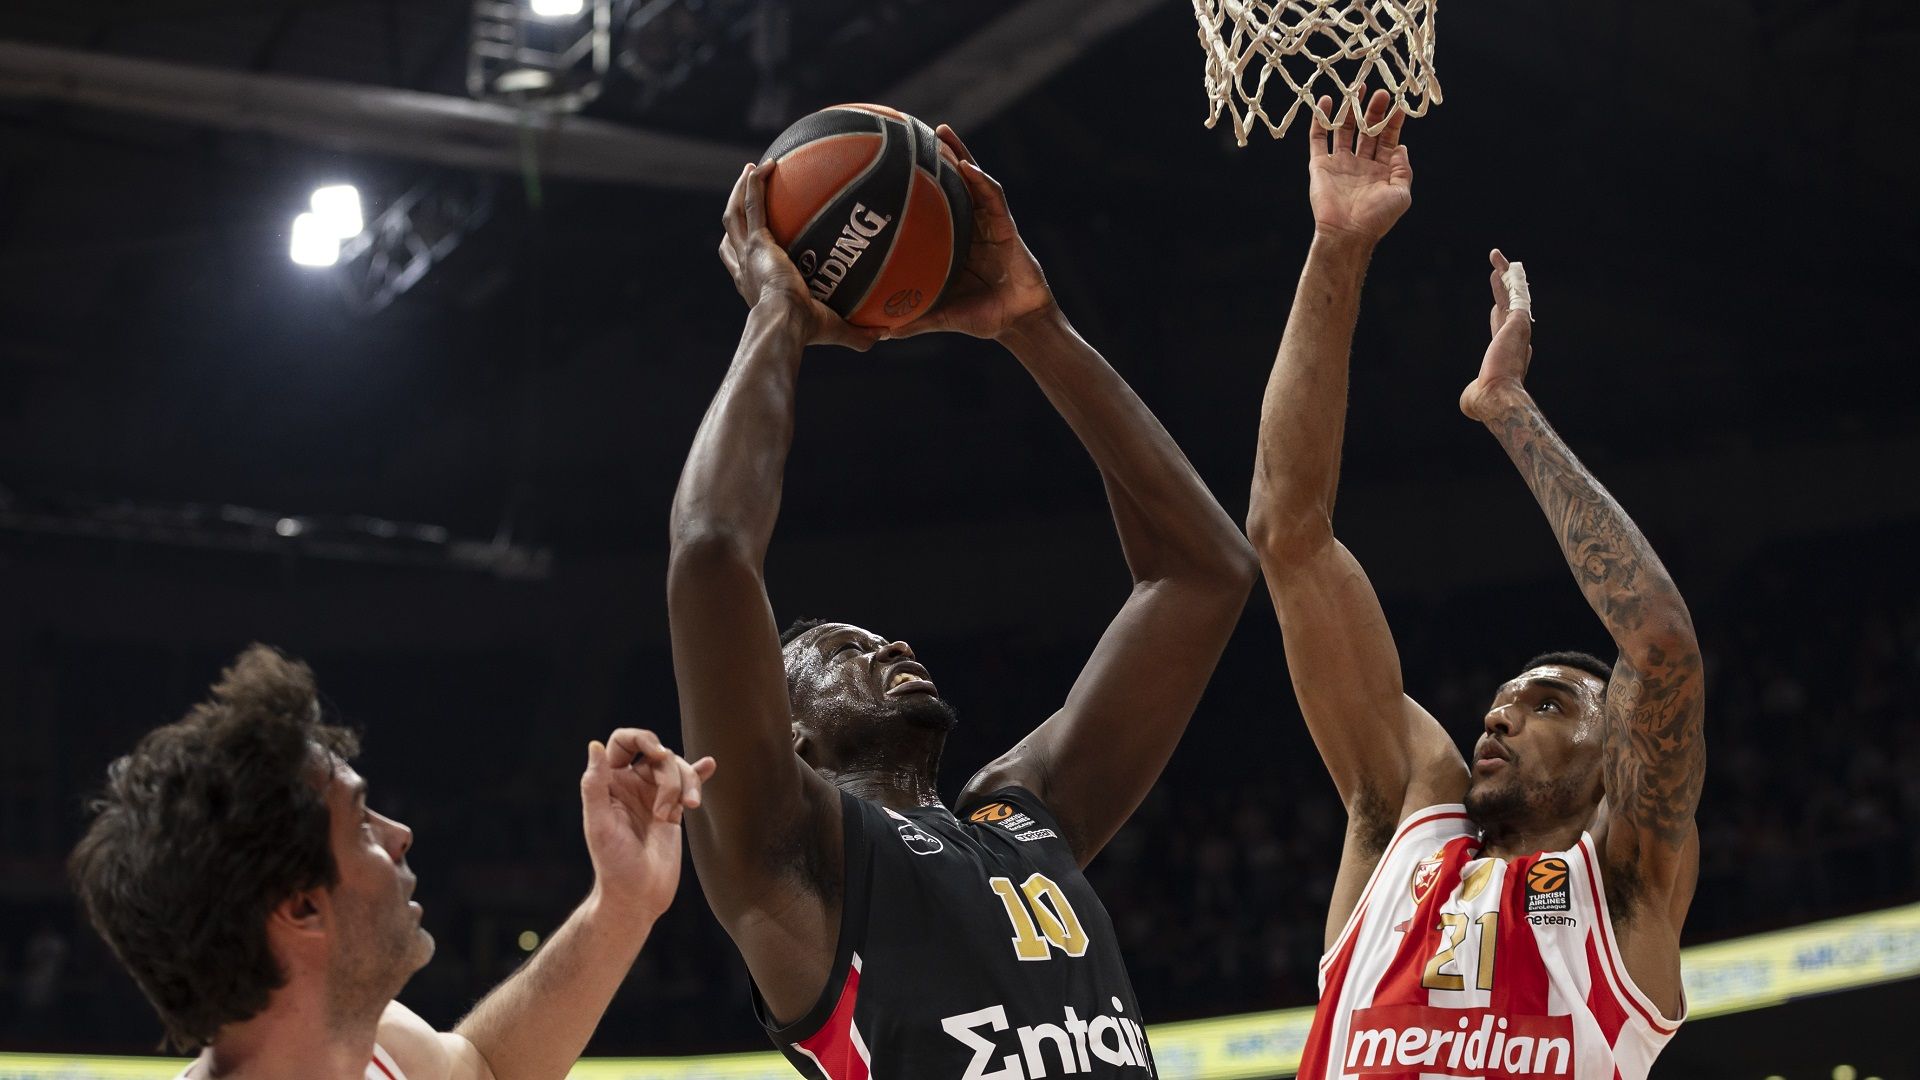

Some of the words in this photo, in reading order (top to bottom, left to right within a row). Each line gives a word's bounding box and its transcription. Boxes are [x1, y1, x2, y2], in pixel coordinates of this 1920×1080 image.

[811, 202, 888, 302] ALDING
[989, 872, 1090, 961] 10
[1529, 891, 1566, 901] TURKISH
[1529, 897, 1566, 906] AIRLINES
[1422, 911, 1499, 991] 21
[1346, 1014, 1571, 1075] meridian
